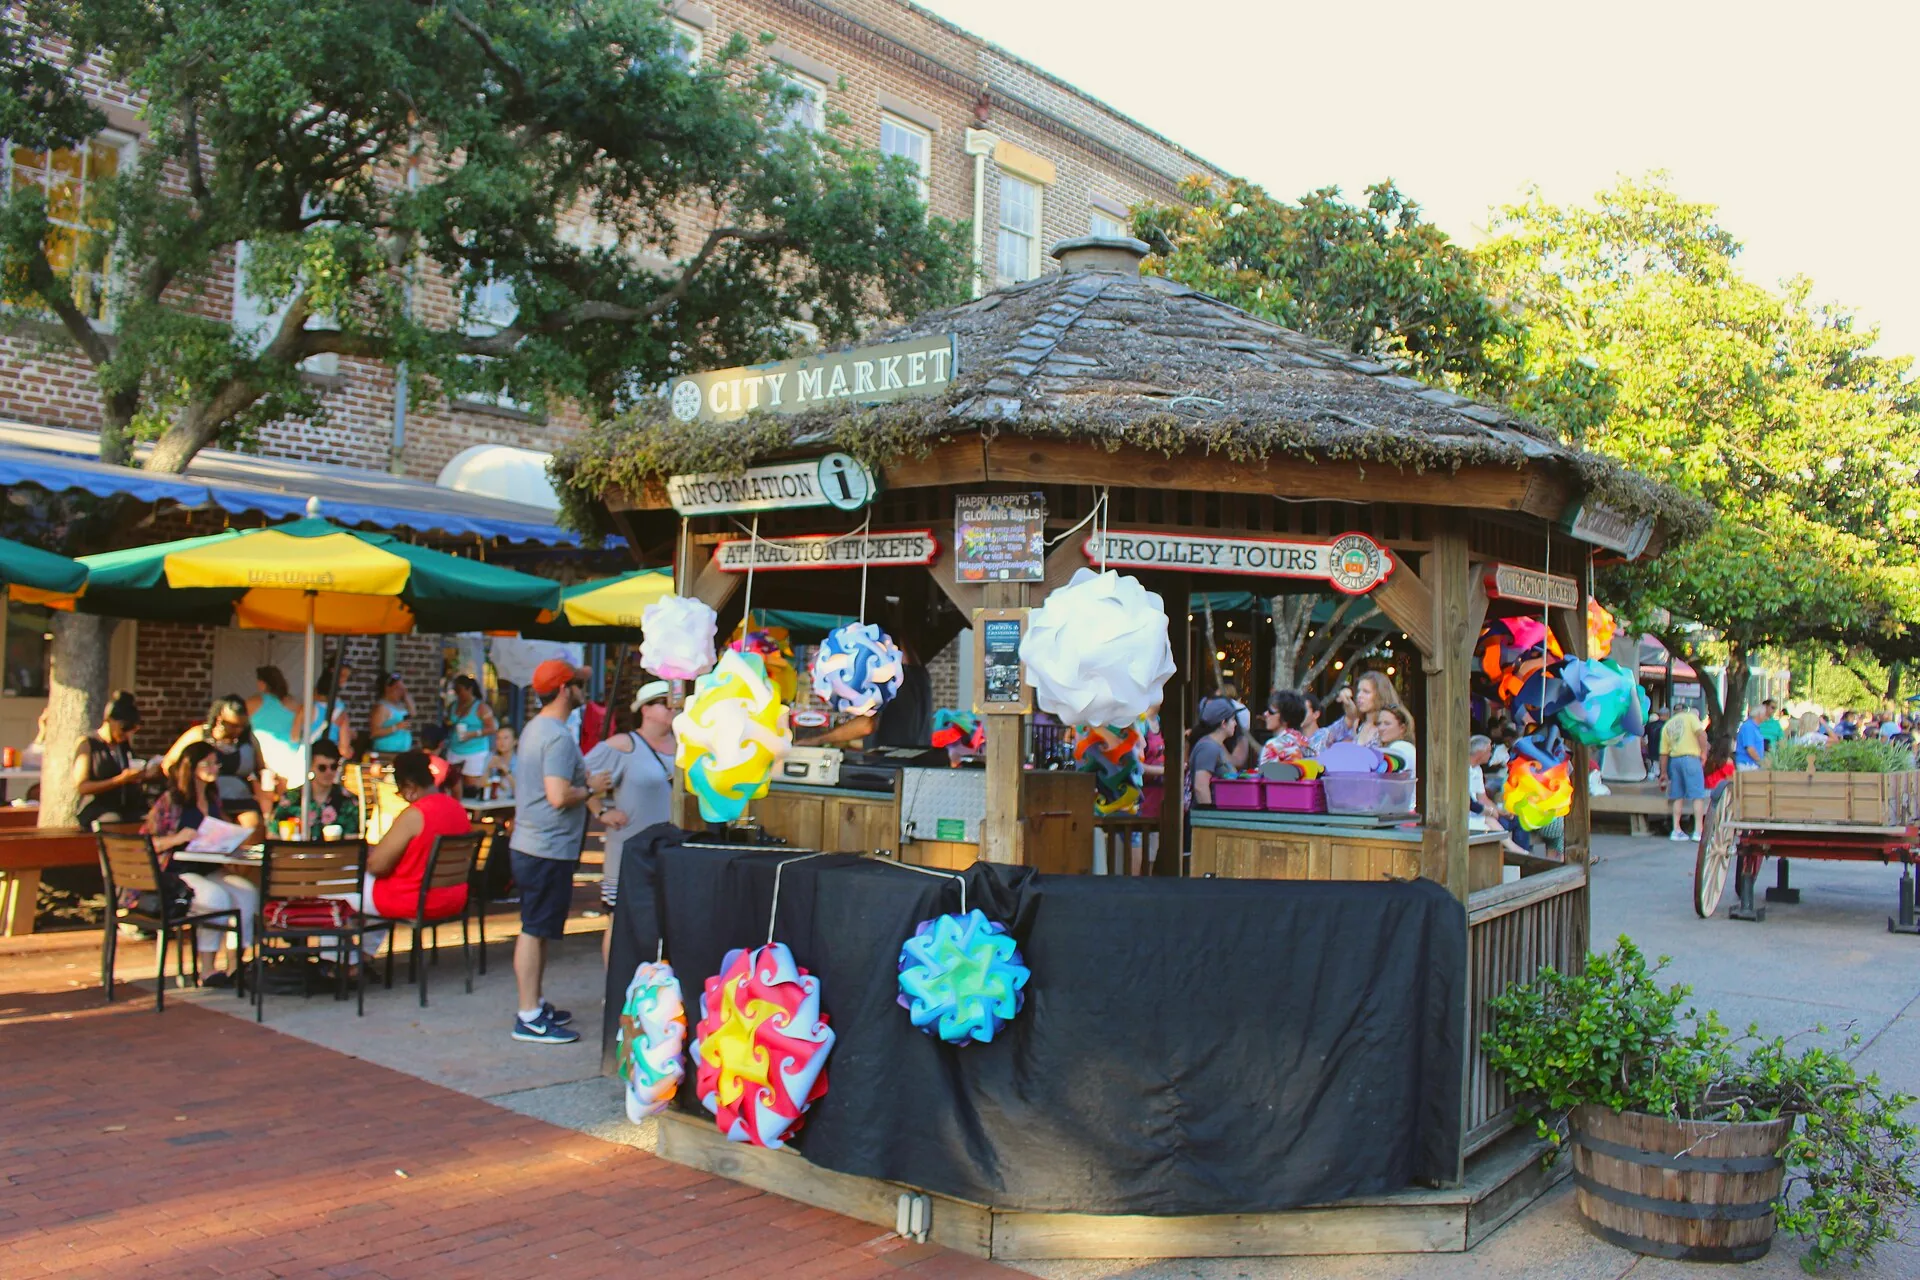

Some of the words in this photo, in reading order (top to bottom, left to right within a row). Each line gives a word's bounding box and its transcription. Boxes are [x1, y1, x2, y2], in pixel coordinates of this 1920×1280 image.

[708, 373, 787, 413] CITY
[797, 347, 951, 402] MARKET
[678, 473, 814, 506] INFORMATION
[958, 496, 989, 507] HAPPY
[991, 494, 1030, 506] PAPPY'S
[963, 509, 1008, 521] GLOWING
[842, 536, 924, 560] TICKETS
[1104, 538, 1224, 565] TROLLEY
[1226, 545, 1318, 570] TOURS
